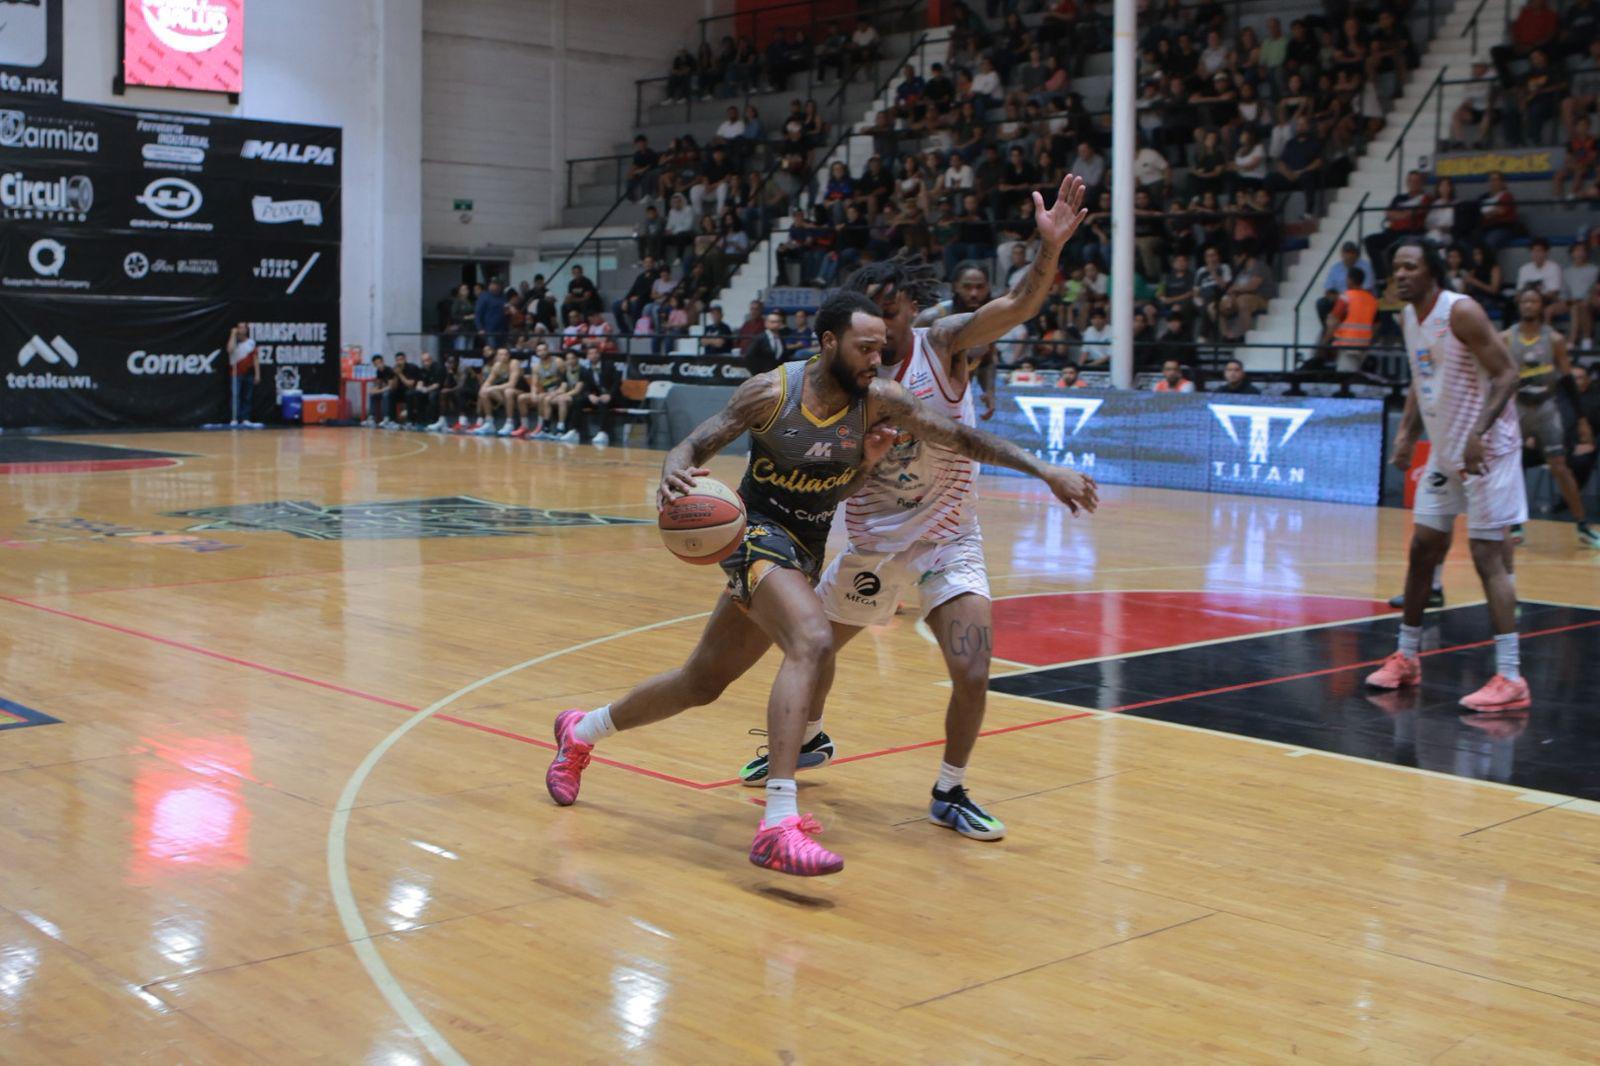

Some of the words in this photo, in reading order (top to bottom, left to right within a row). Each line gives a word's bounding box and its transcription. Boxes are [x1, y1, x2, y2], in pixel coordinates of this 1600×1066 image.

[241, 139, 335, 166] MALPA
[127, 348, 221, 375] Comex
[257, 345, 273, 365] EZ
[721, 364, 753, 379] Com
[1024, 448, 1096, 468] ITAN
[1211, 460, 1305, 483] TITAN
